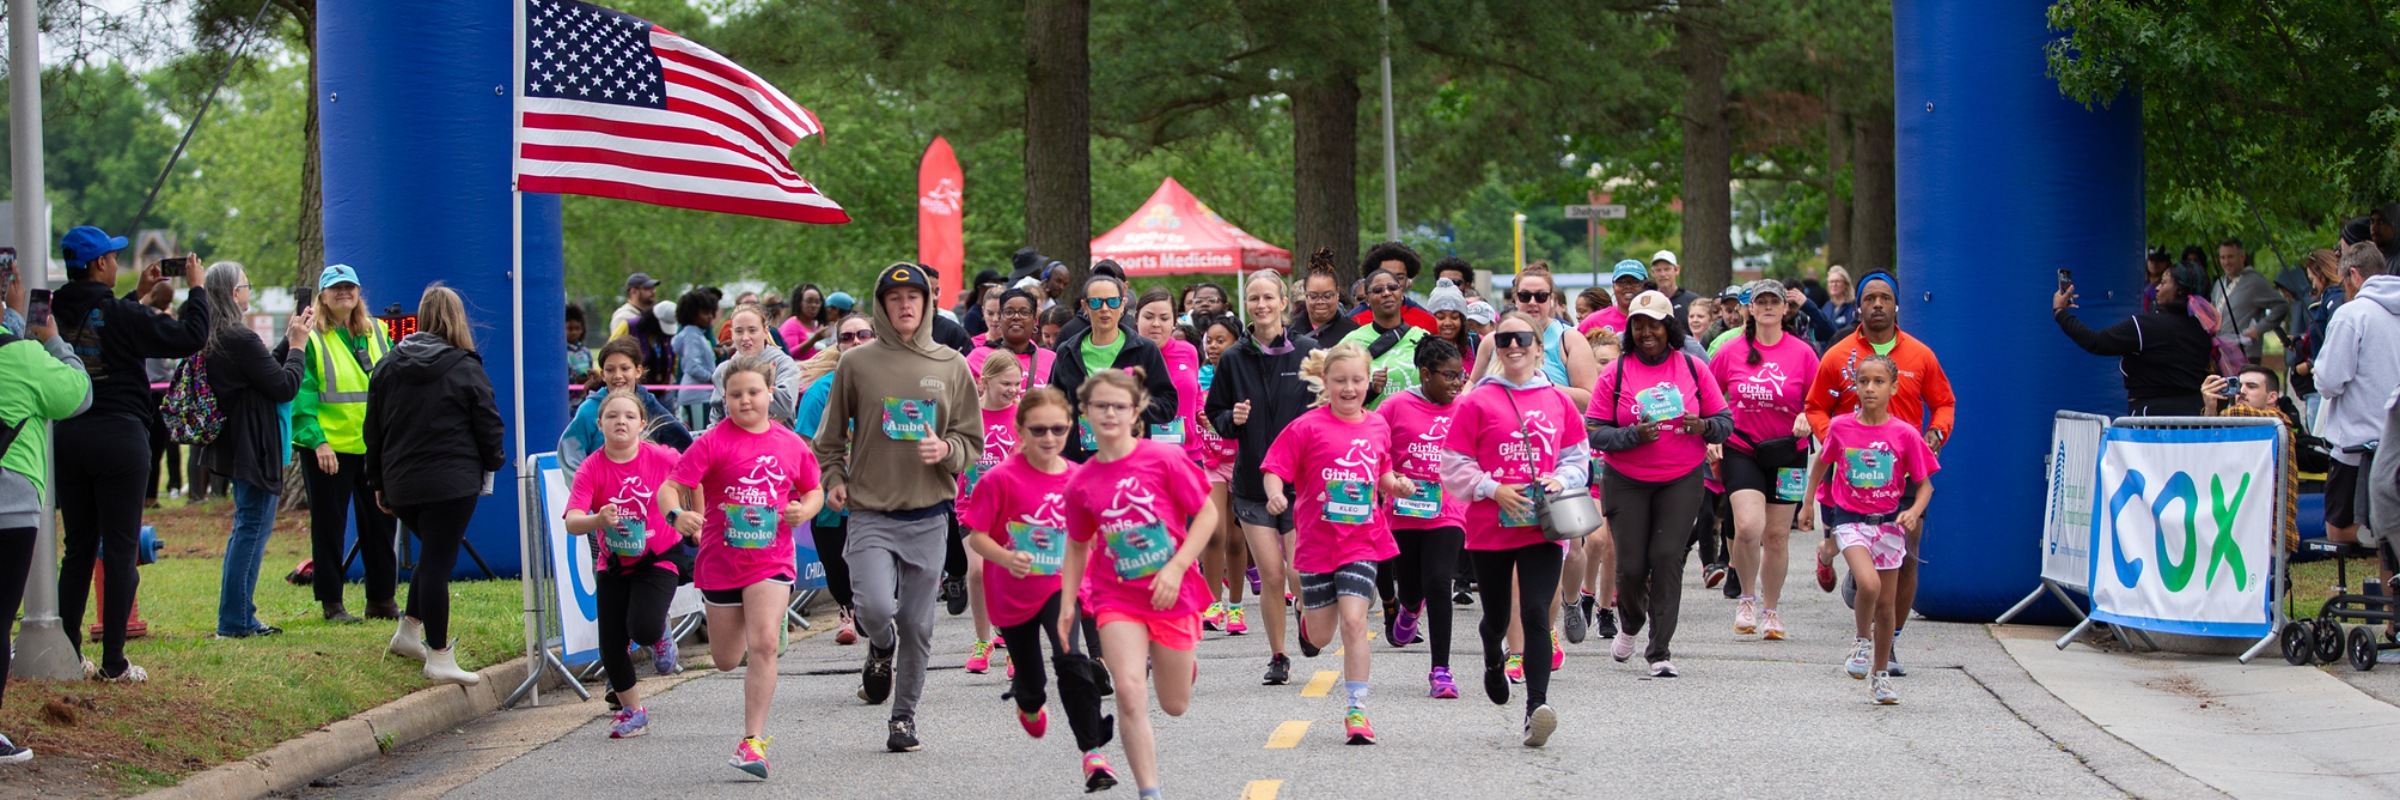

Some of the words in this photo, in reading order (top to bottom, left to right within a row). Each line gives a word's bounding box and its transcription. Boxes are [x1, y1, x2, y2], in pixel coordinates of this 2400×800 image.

[1159, 251, 1233, 268] Medicine
[891, 268, 911, 281] C
[1737, 382, 1766, 394] Girls
[1751, 393, 1774, 401] run
[887, 420, 928, 432] Ambe
[1408, 442, 1440, 454] Girls
[1321, 467, 1357, 481] Girls
[1852, 468, 1885, 480] Leela
[739, 494, 768, 505] run
[727, 527, 773, 541] Brooke
[2110, 468, 2251, 593] COX
[604, 537, 643, 550] Rachel
[1033, 552, 1062, 566] lina
[1118, 547, 1169, 571] Hailey
